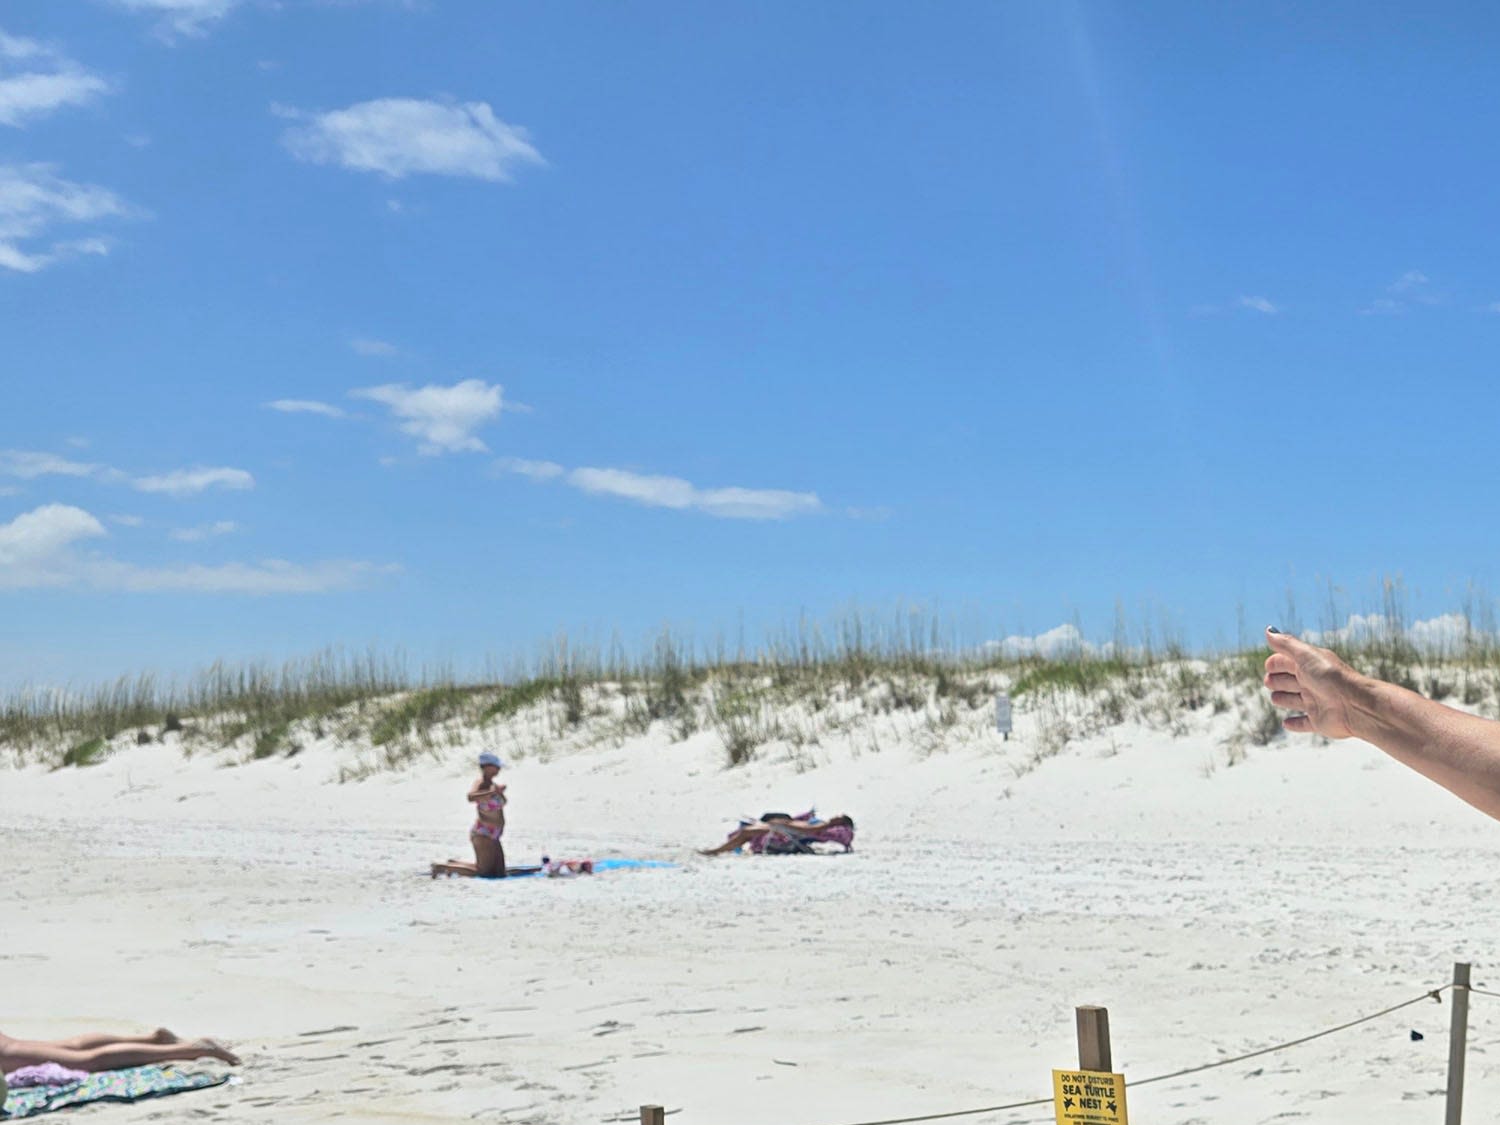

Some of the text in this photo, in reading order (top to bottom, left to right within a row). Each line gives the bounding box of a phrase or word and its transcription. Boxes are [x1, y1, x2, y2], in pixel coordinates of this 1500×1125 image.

[1061, 1074, 1115, 1086] DO NOT DISTURB
[1063, 1084, 1115, 1098] SEA TURTLE
[1079, 1097, 1102, 1110] NEST
